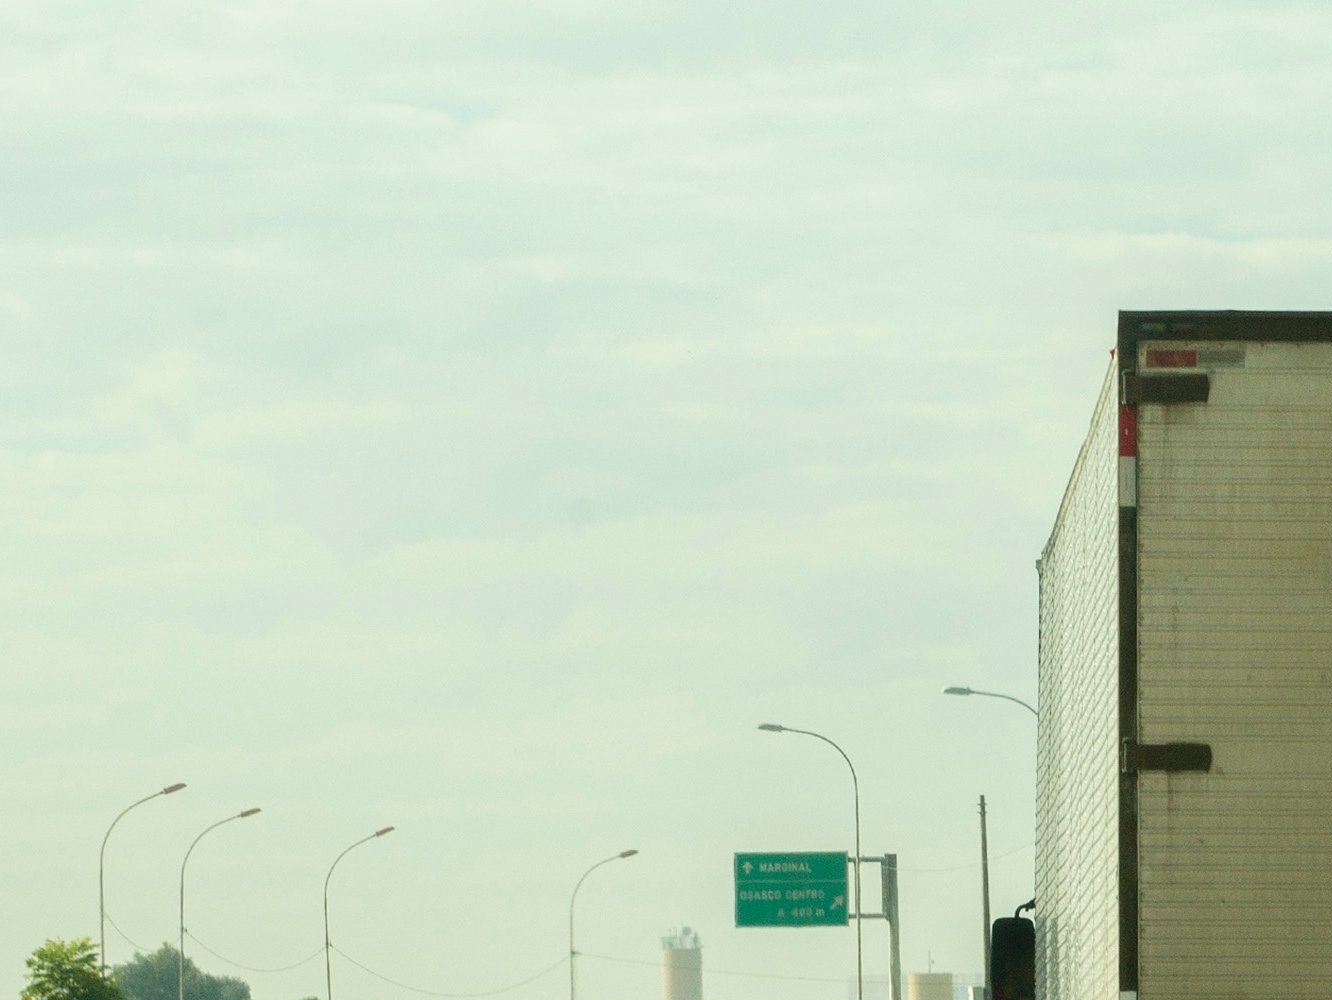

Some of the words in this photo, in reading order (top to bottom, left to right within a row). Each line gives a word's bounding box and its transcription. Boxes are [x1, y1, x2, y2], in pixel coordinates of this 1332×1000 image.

[759, 863, 812, 873] MARGINAL
[739, 890, 782, 900] OSASCO
[785, 889, 825, 900] CENTRO
[791, 907, 813, 917] 400
[815, 909, 825, 917] m
